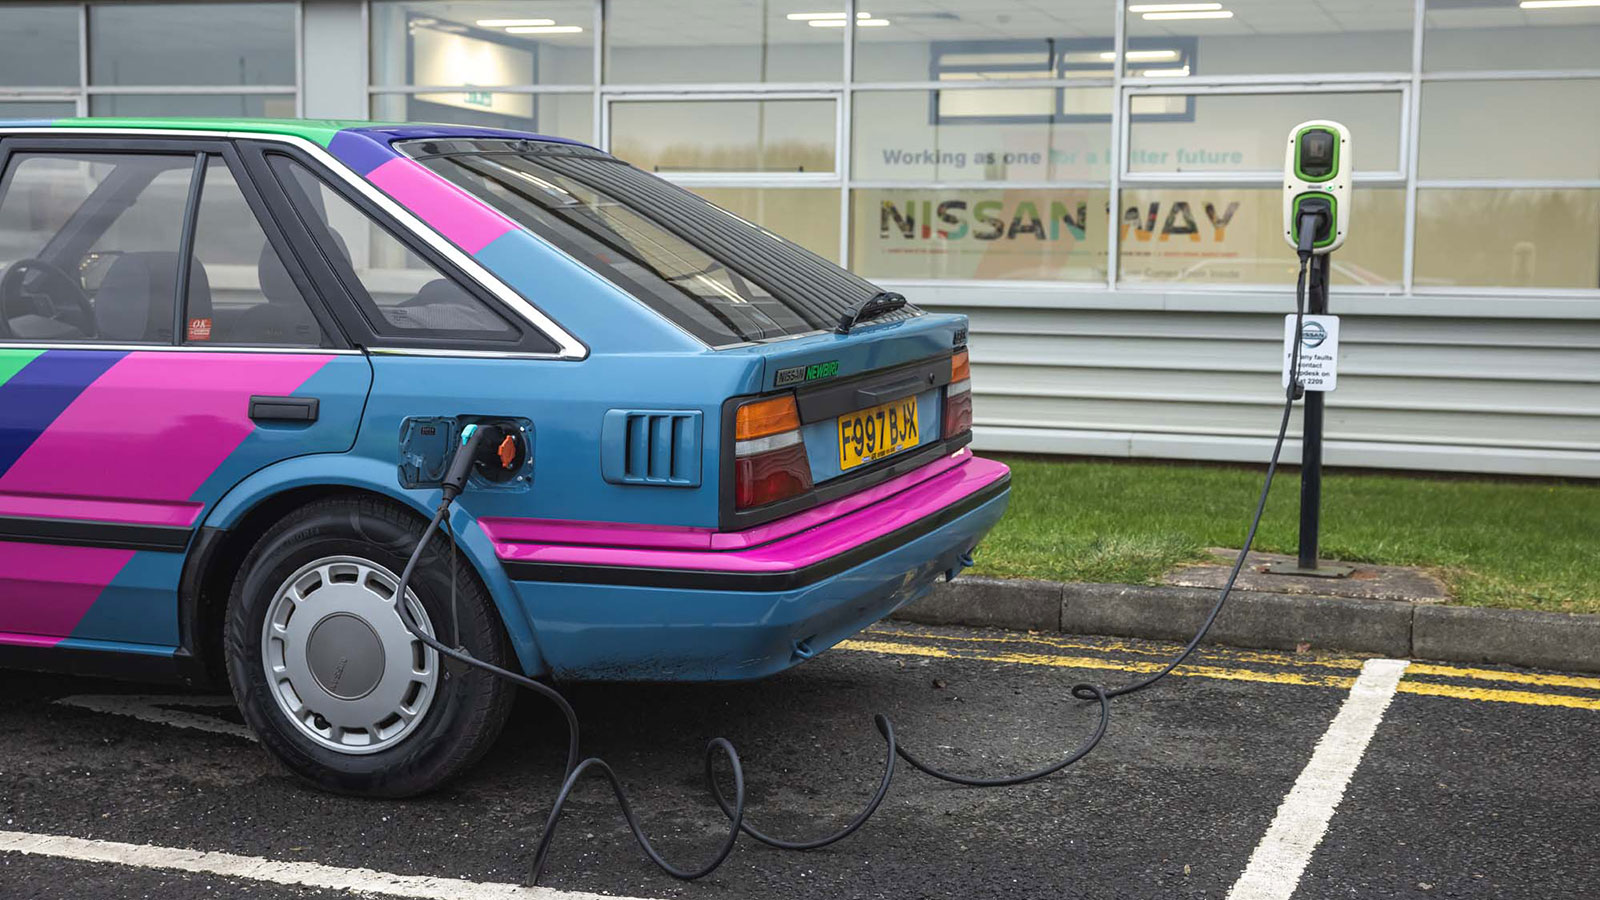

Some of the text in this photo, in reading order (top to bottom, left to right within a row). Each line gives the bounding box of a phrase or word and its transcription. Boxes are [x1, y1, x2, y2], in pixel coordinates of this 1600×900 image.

[882, 150, 967, 169] Working
[974, 152, 996, 165] as
[1003, 152, 1042, 165] one
[1176, 149, 1243, 165] future
[880, 199, 1240, 242] NISSAN WAY
[778, 361, 839, 384] NISSAN NEWBIRD
[842, 401, 917, 462] F997 BJX
